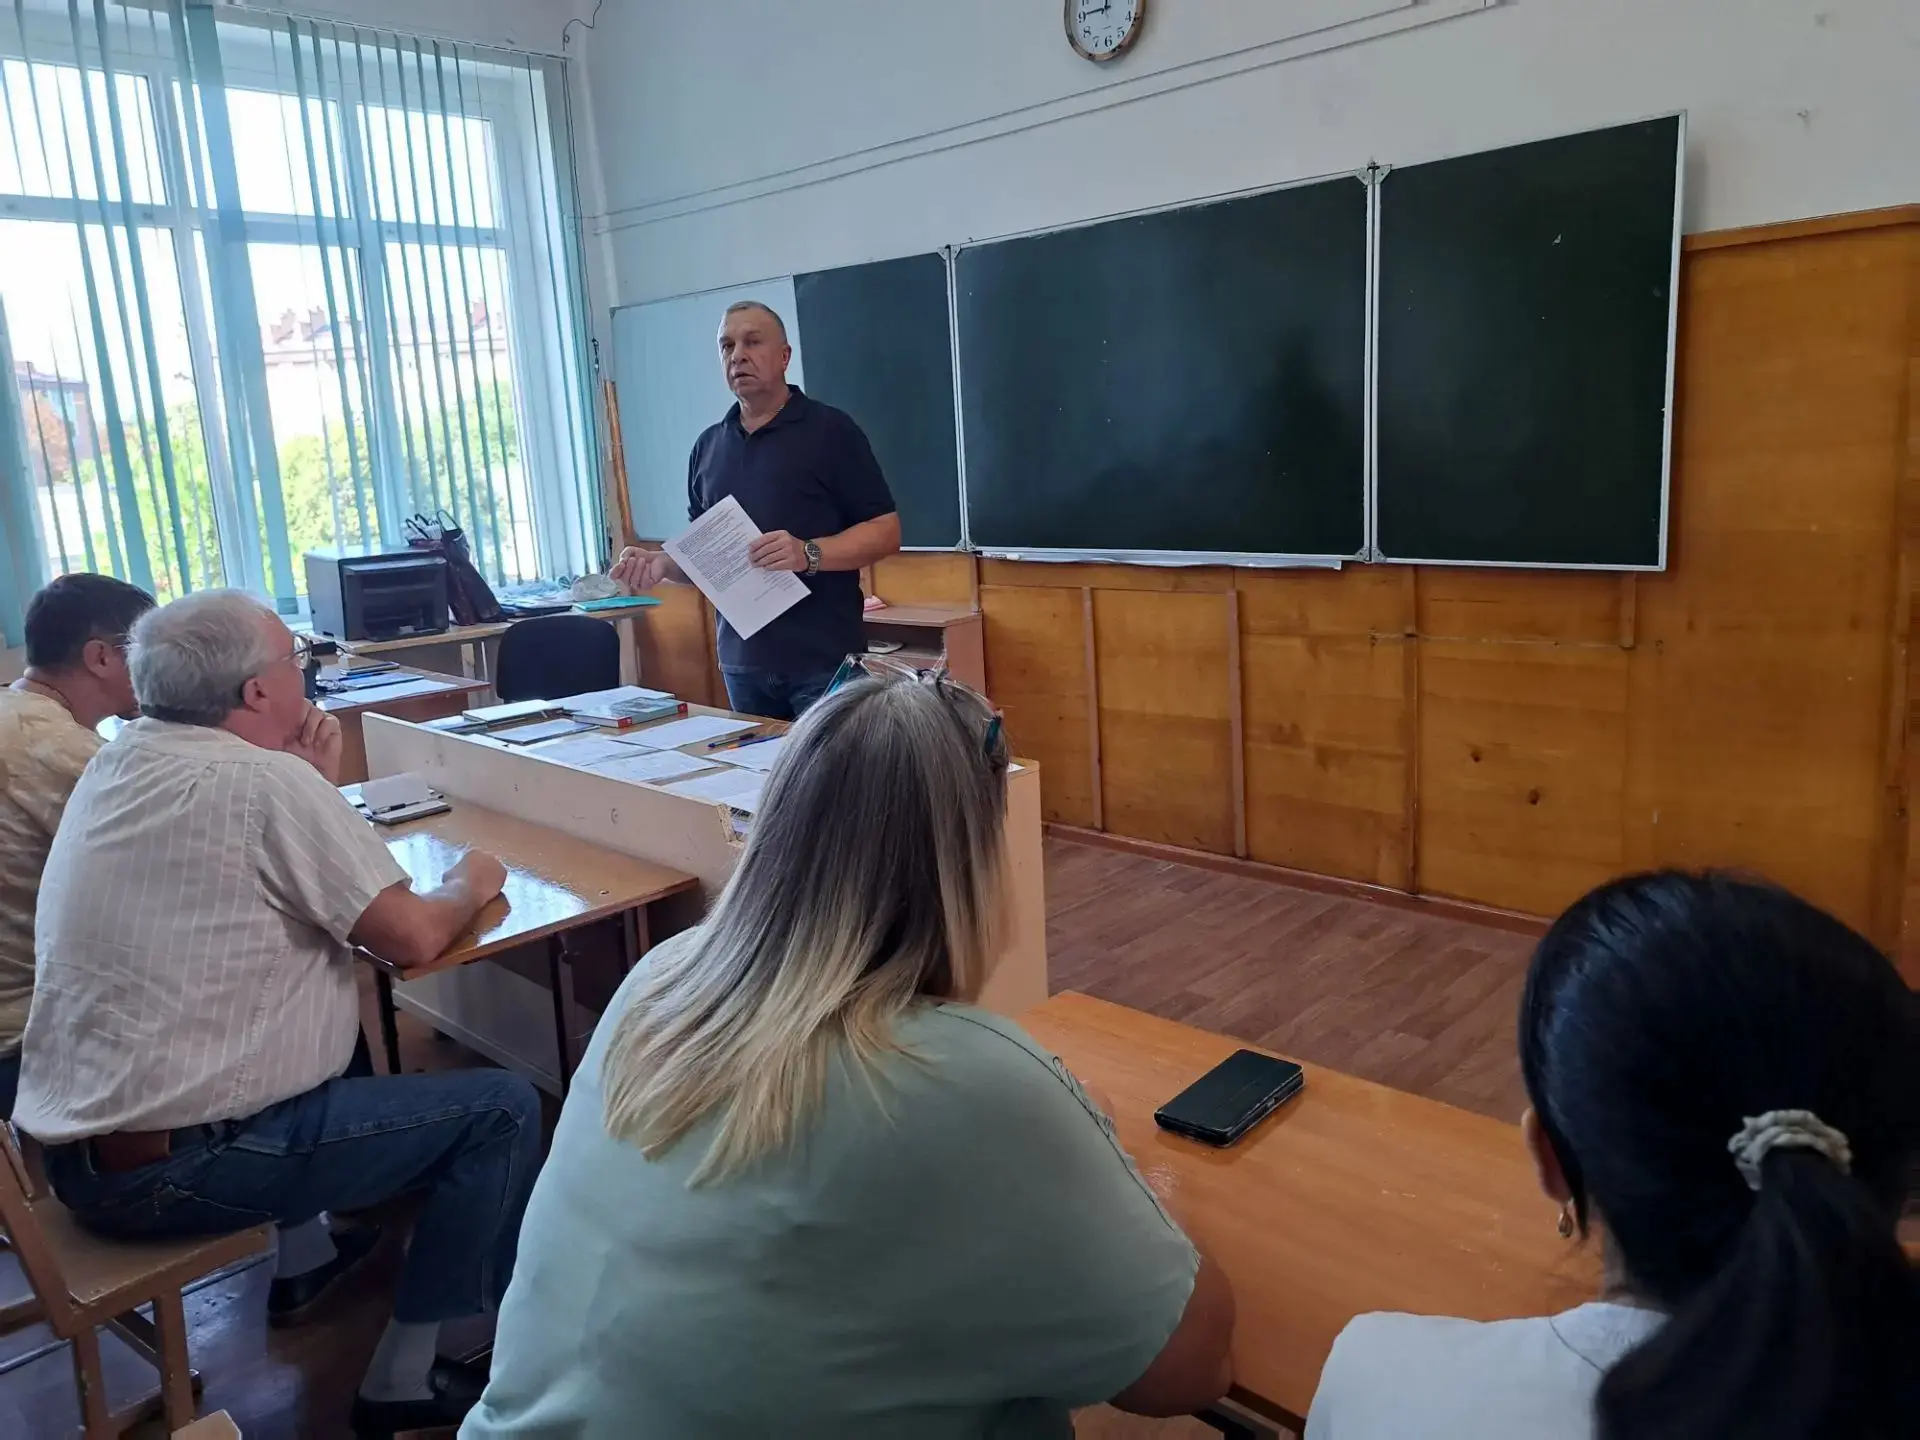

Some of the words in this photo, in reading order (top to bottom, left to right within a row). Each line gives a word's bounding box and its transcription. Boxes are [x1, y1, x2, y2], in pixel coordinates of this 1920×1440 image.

[1078, 11, 1086, 23] 9
[1125, 10, 1132, 22] 4
[1083, 26, 1091, 38] 8
[1117, 26, 1124, 38] 5
[1092, 36, 1099, 47] 7
[1104, 35, 1112, 47] 6
